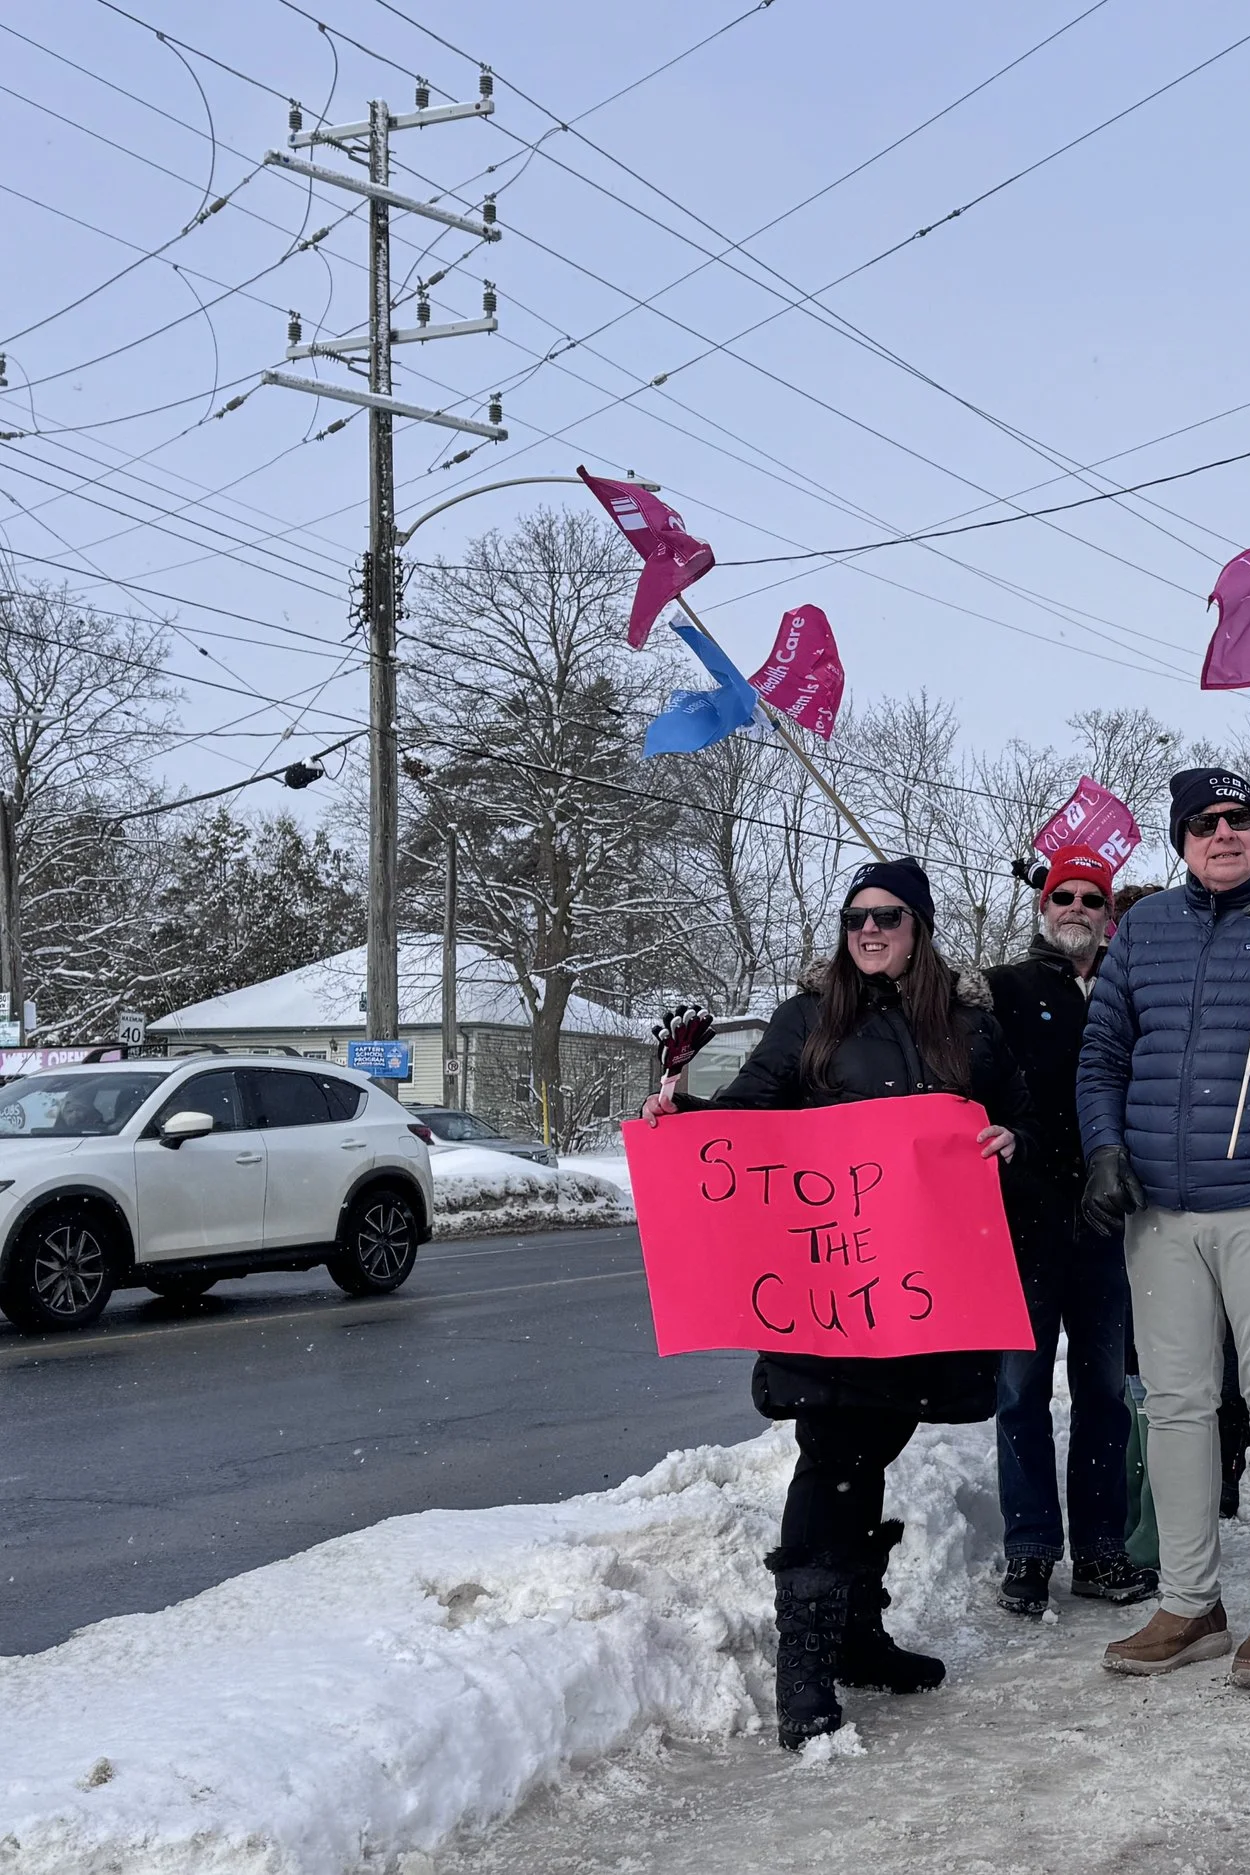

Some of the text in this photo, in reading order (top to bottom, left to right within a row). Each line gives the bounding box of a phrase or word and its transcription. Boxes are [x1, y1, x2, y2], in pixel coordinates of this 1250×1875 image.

[775, 616, 805, 663] Care
[1215, 788, 1247, 802] CUPE
[1097, 828, 1132, 868] PE
[120, 1027, 141, 1043] 40
[699, 1137, 884, 1218] STOP
[787, 1220, 878, 1267] THE
[751, 1270, 934, 1338] CUTS
